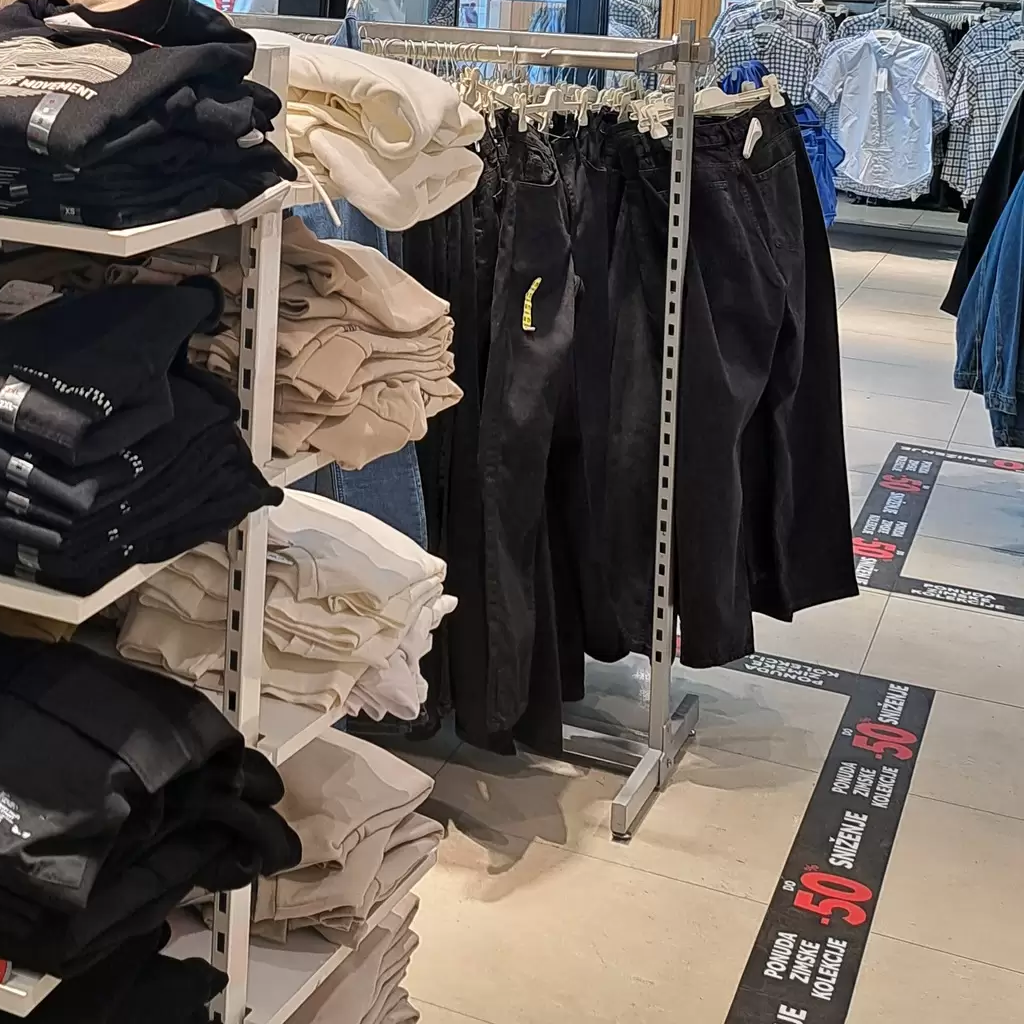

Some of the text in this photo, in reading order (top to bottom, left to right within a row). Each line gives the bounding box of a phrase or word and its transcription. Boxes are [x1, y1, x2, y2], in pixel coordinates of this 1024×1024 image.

[18, 77, 98, 101] MOVEMENT
[744, 654, 840, 678] KOLEKCIJ
[877, 683, 910, 726] SNIŽENJE
[831, 761, 858, 795] PONUDA
[852, 767, 877, 798] ZIMSKE
[871, 766, 899, 809] KOLEKCIJE
[828, 810, 869, 870] SNIŽENJE
[782, 880, 797, 892] DO
[764, 931, 798, 980] PONUDA
[789, 939, 821, 984] ZIMSKE
[811, 936, 848, 1001] KOLEKCIJE
